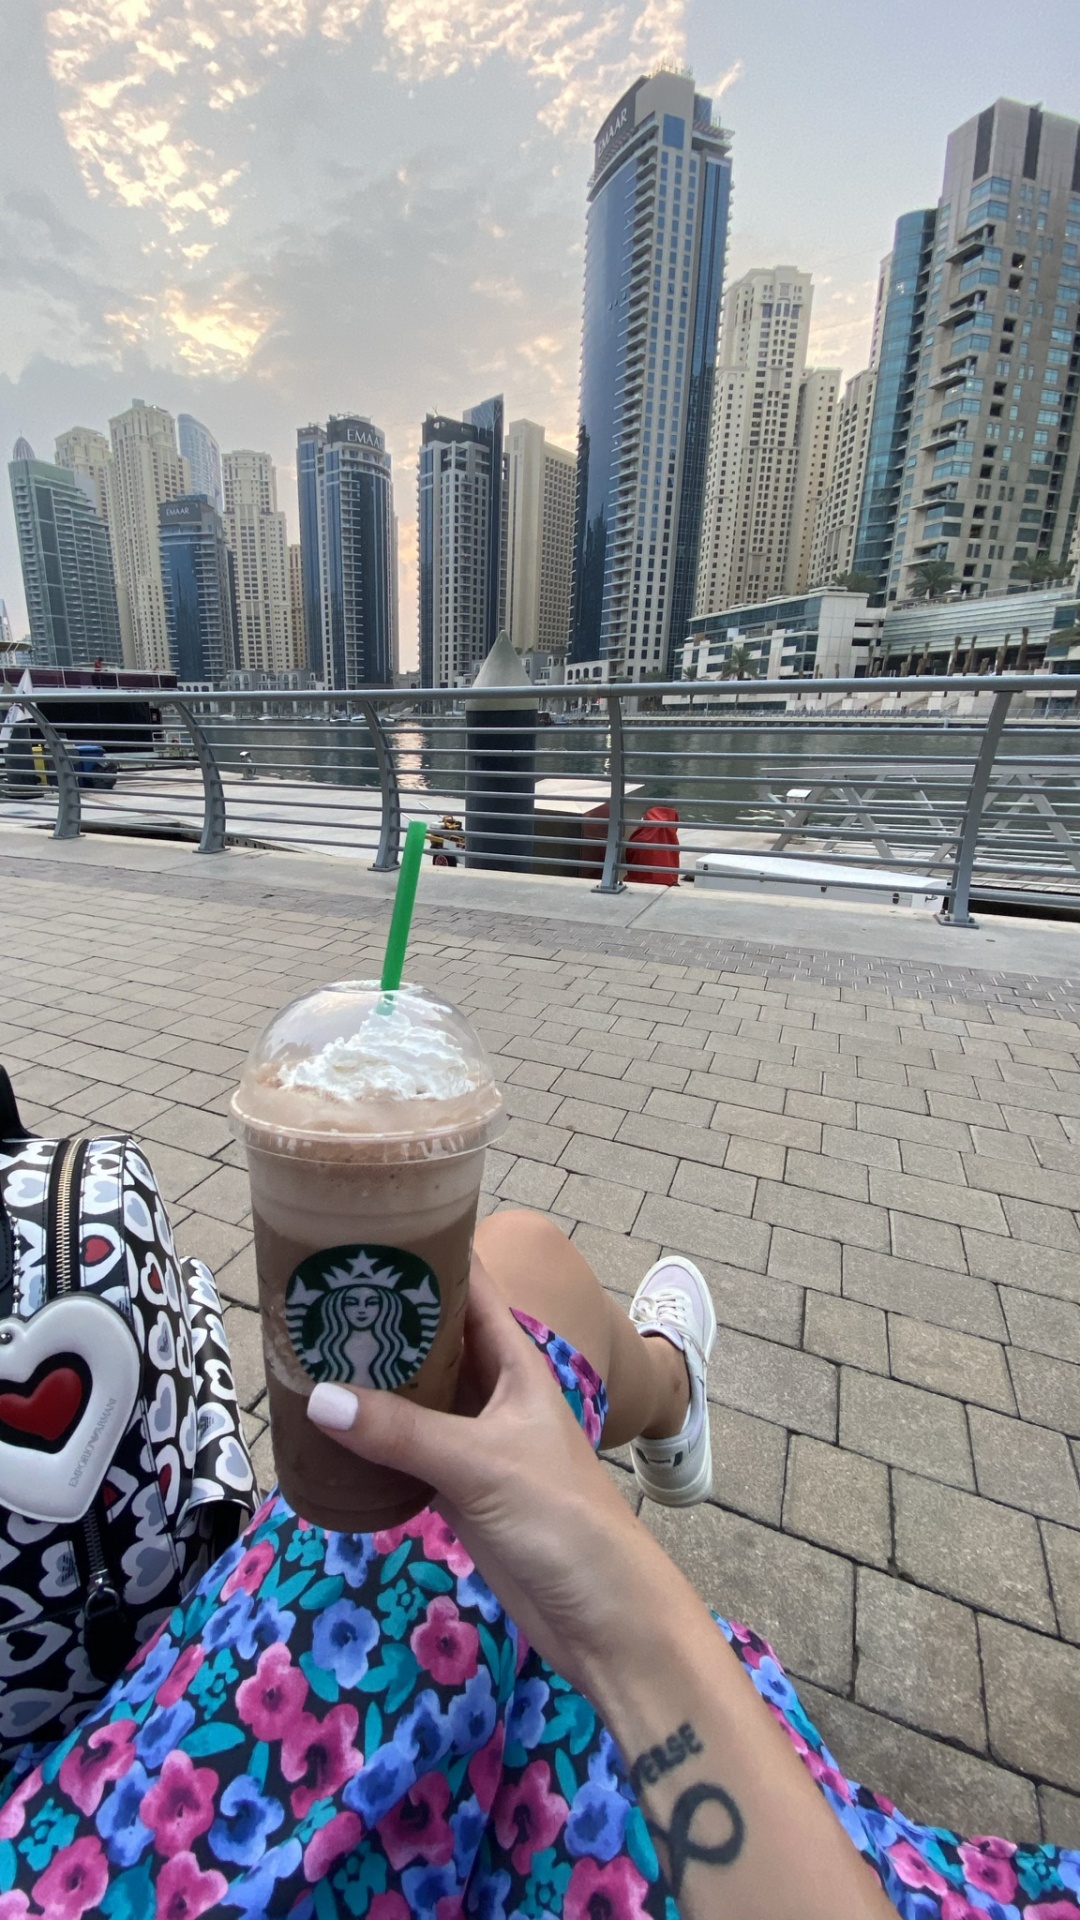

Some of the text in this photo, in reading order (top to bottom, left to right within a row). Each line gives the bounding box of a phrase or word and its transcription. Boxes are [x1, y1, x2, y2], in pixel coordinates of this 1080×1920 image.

[598, 107, 628, 158] EMAAR
[165, 507, 190, 516] EMAAR
[67, 1398, 117, 1488] EMPORIO ARMANI
